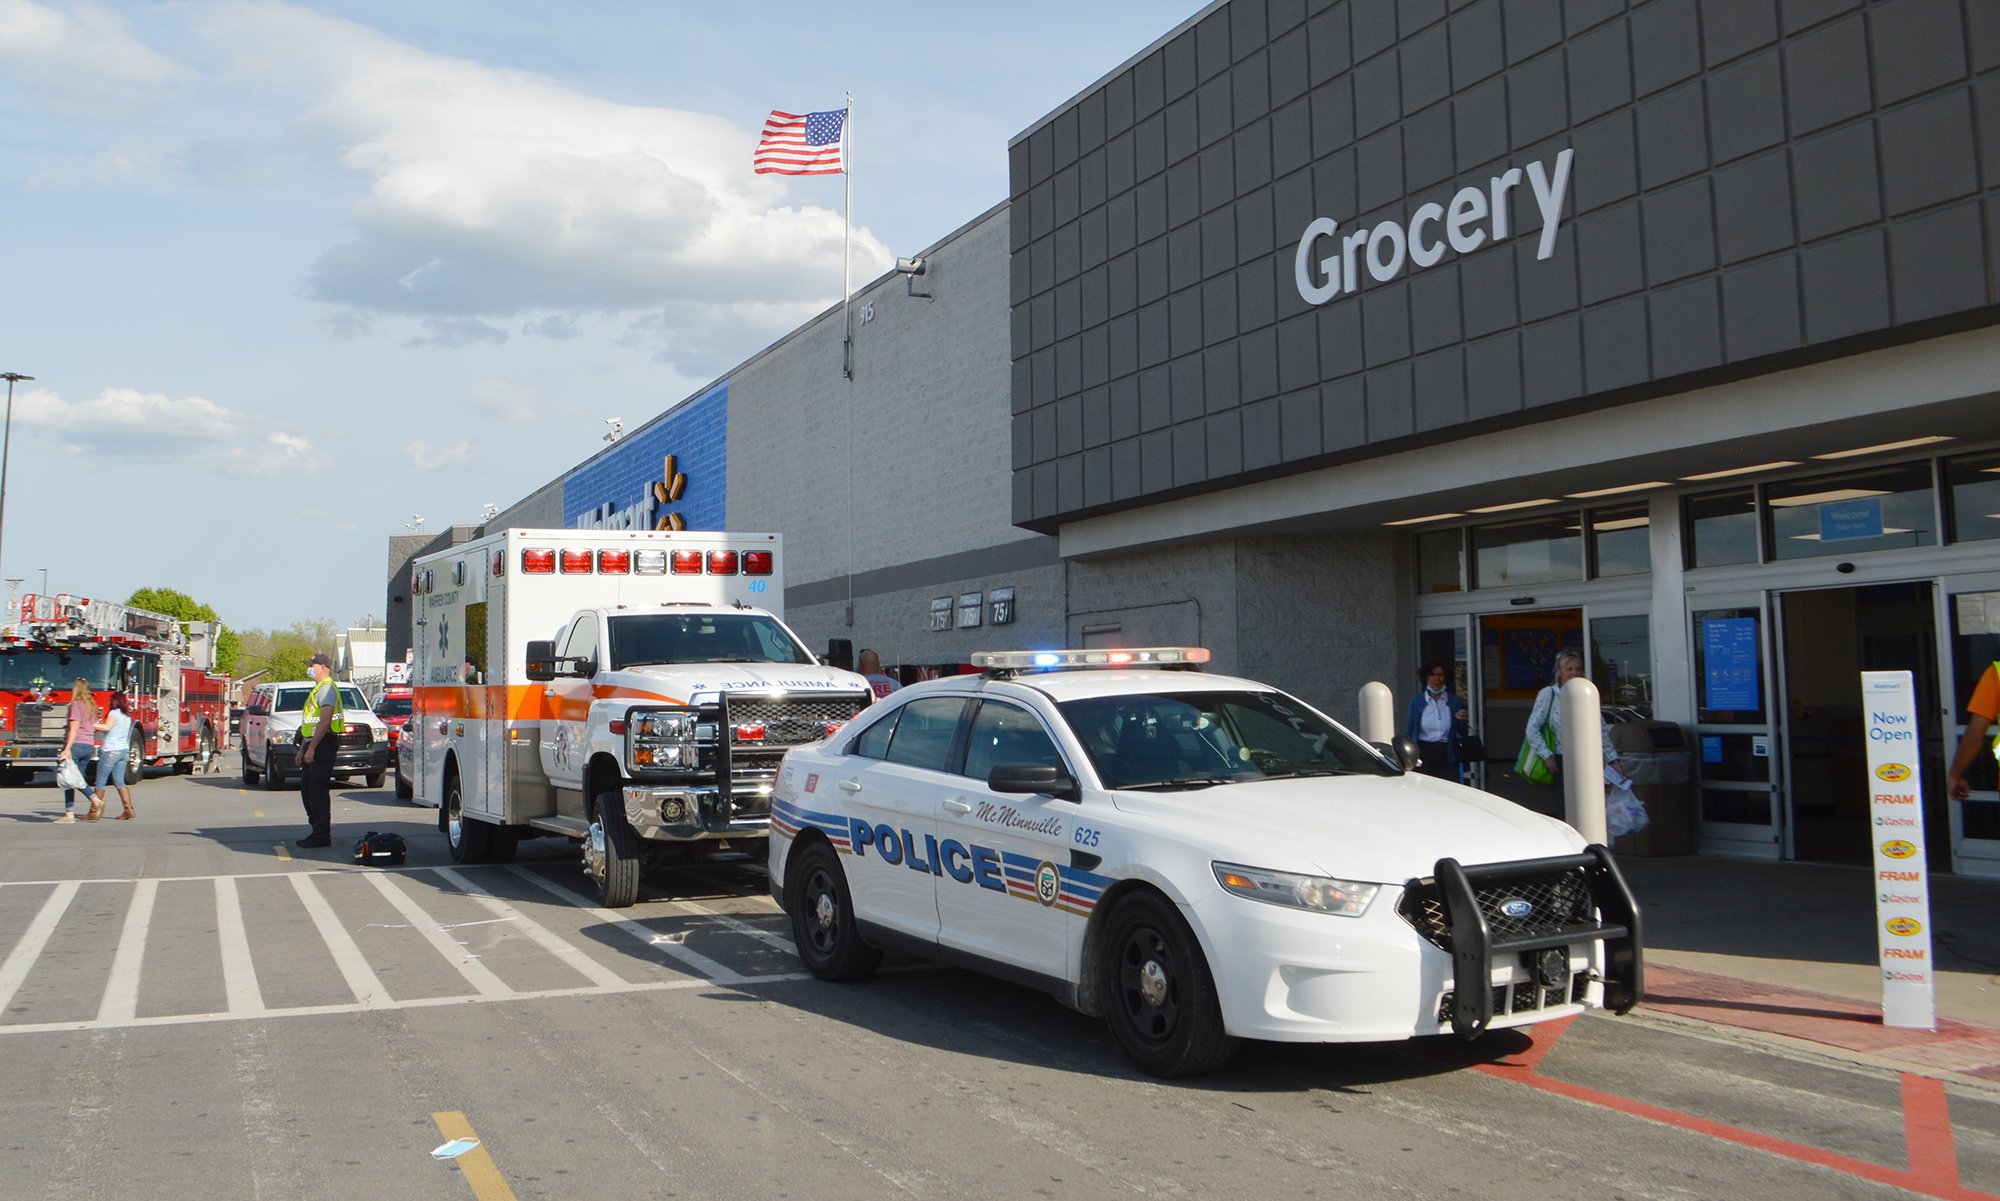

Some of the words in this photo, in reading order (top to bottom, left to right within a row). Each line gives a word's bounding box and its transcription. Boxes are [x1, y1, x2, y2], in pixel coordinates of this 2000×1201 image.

[1295, 148, 1574, 305] Grocery
[860, 301, 875, 325] 915
[577, 481, 655, 530] Wlmart
[748, 579, 767, 593] 40
[873, 682, 892, 696] RE
[1873, 711, 1907, 724] Now
[1869, 727, 1913, 744] Open
[1873, 794, 1915, 804] FRAM
[976, 801, 1062, 837] McMinnville
[1883, 818, 1916, 826] Castrol
[1074, 826, 1100, 847] 625
[849, 817, 1007, 894] POLICE
[1879, 871, 1920, 882] FRAM
[1888, 894, 1920, 903] Castrol
[1884, 948, 1925, 960] FRAM
[1893, 971, 1925, 981] Castrol
